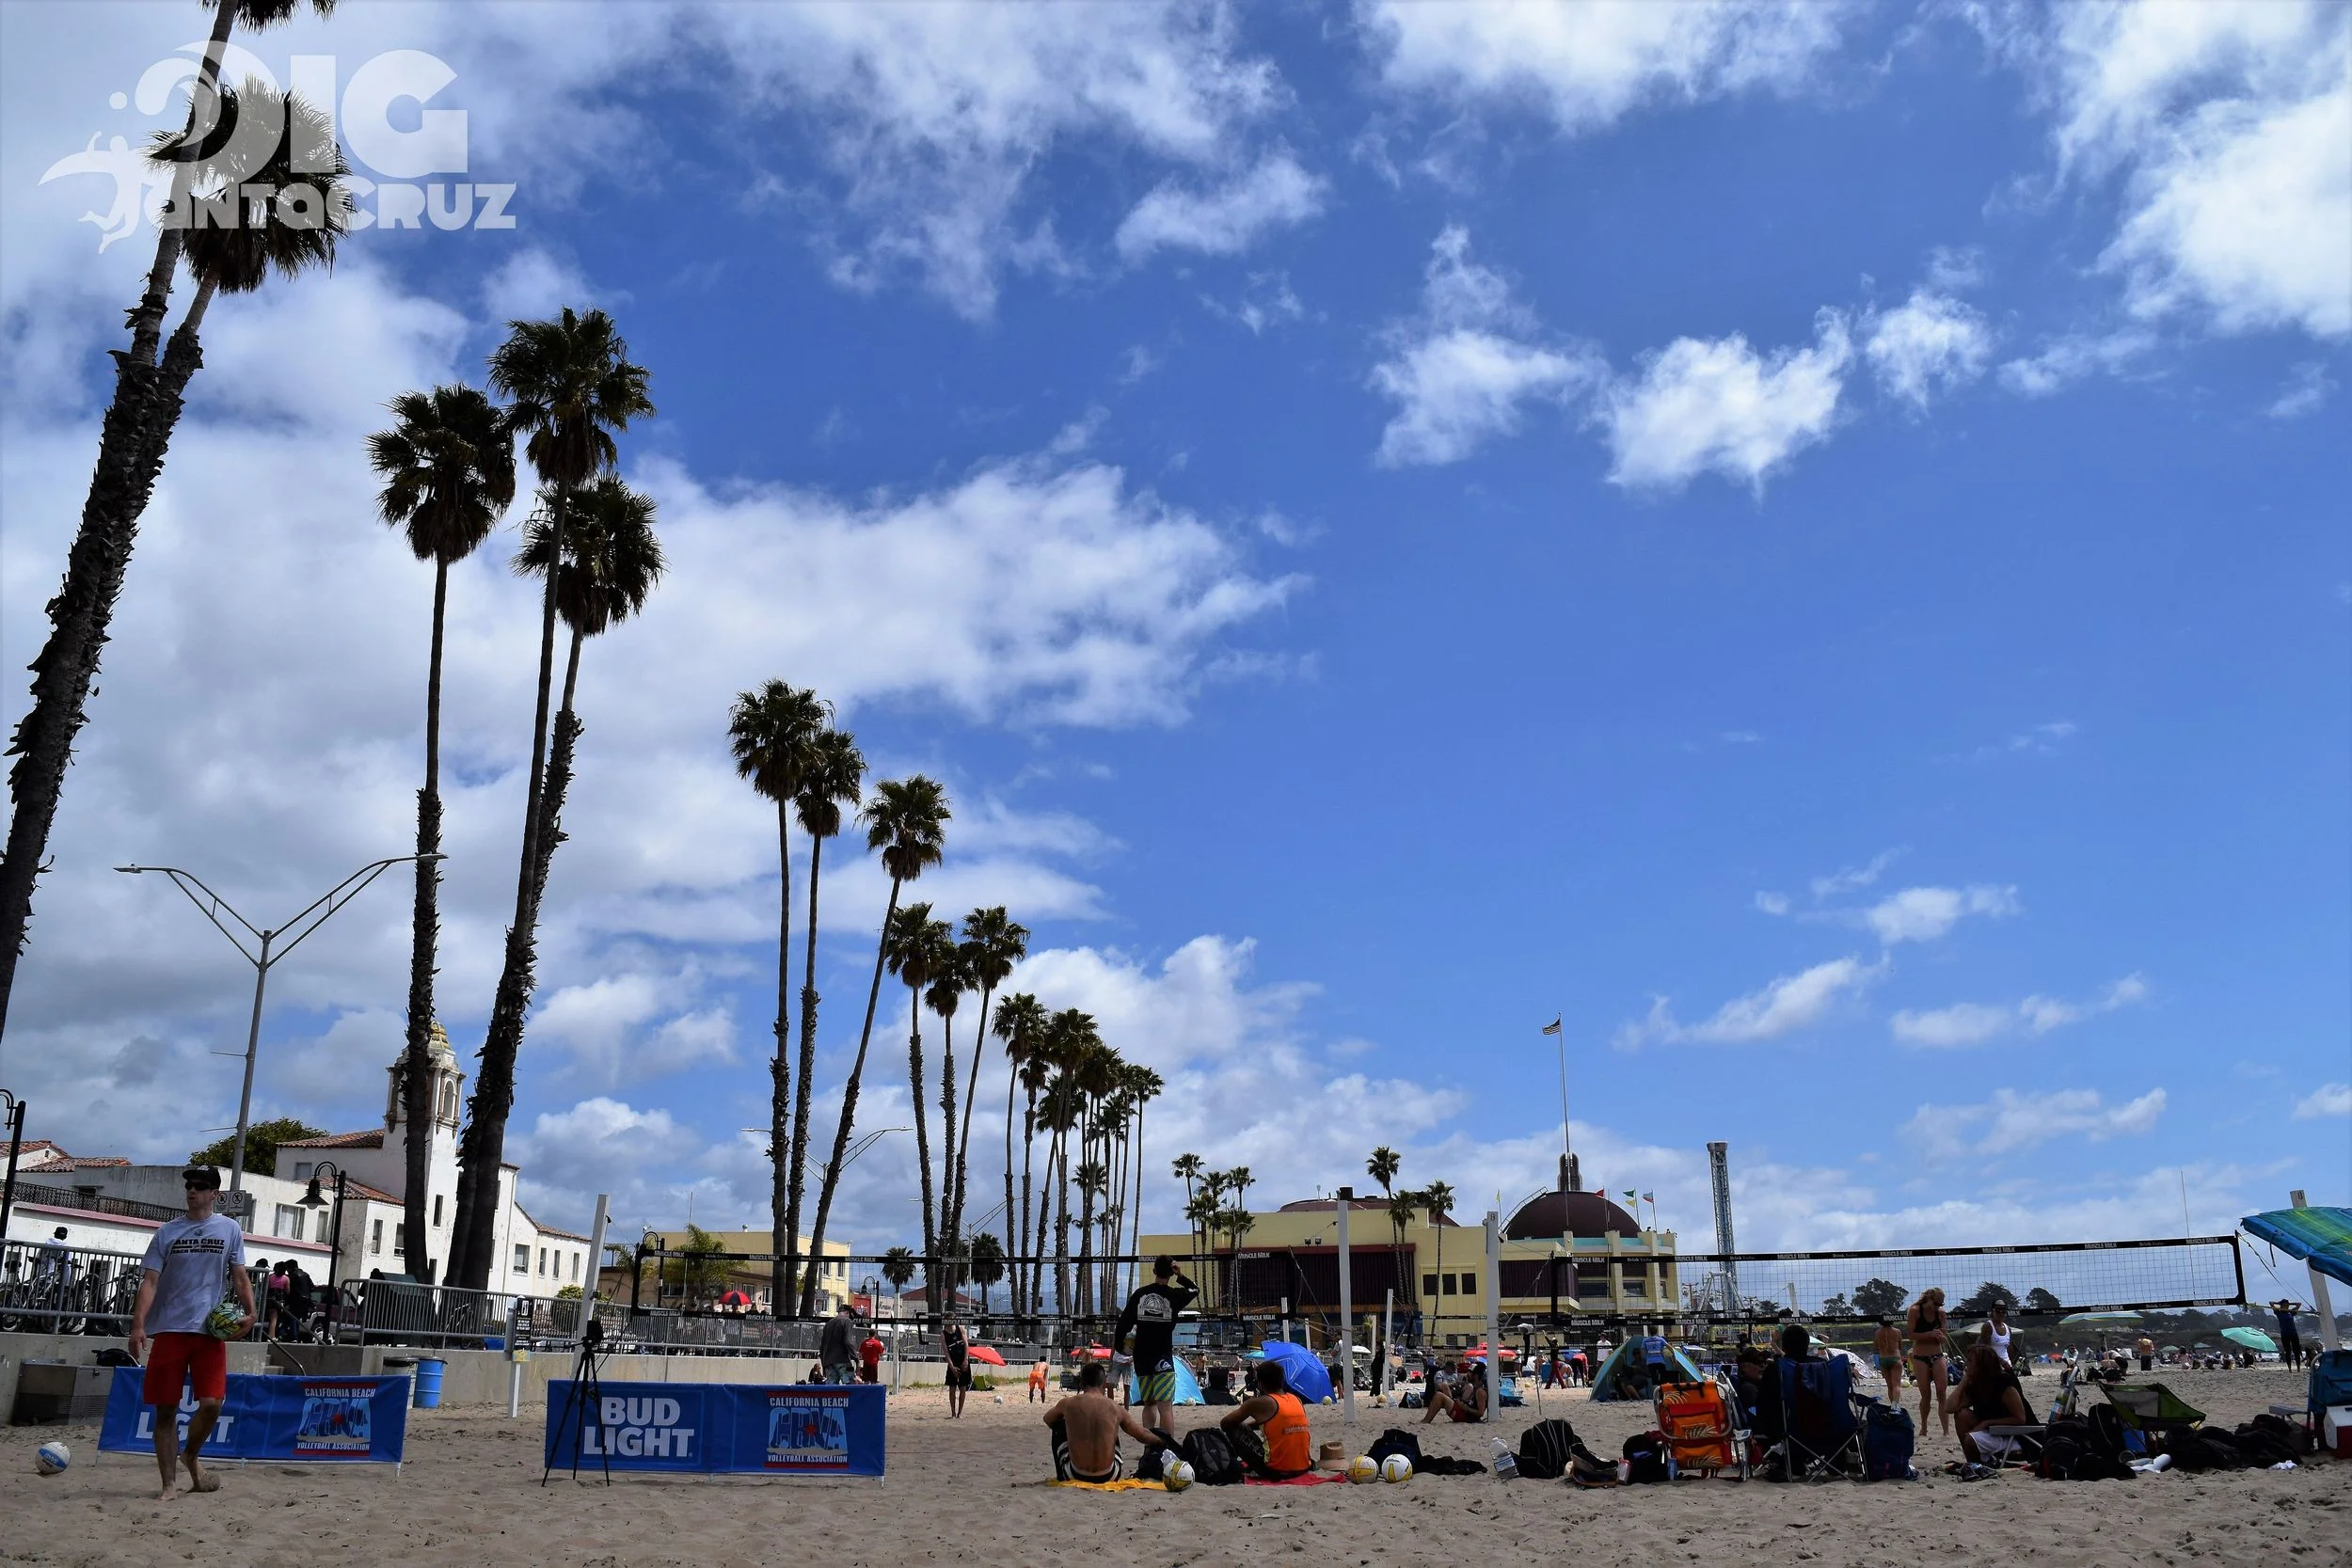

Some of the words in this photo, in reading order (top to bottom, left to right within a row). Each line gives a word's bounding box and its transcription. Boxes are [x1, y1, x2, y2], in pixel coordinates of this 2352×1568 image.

[305, 1387, 349, 1397] CALIFORNIA
[352, 1388, 376, 1398] BEACH
[770, 1397, 819, 1407] CALIFORNIA
[822, 1398, 849, 1407] BEACH
[600, 1397, 680, 1426] BUD
[135, 1411, 234, 1443] LGT
[583, 1426, 694, 1458] LIGHT
